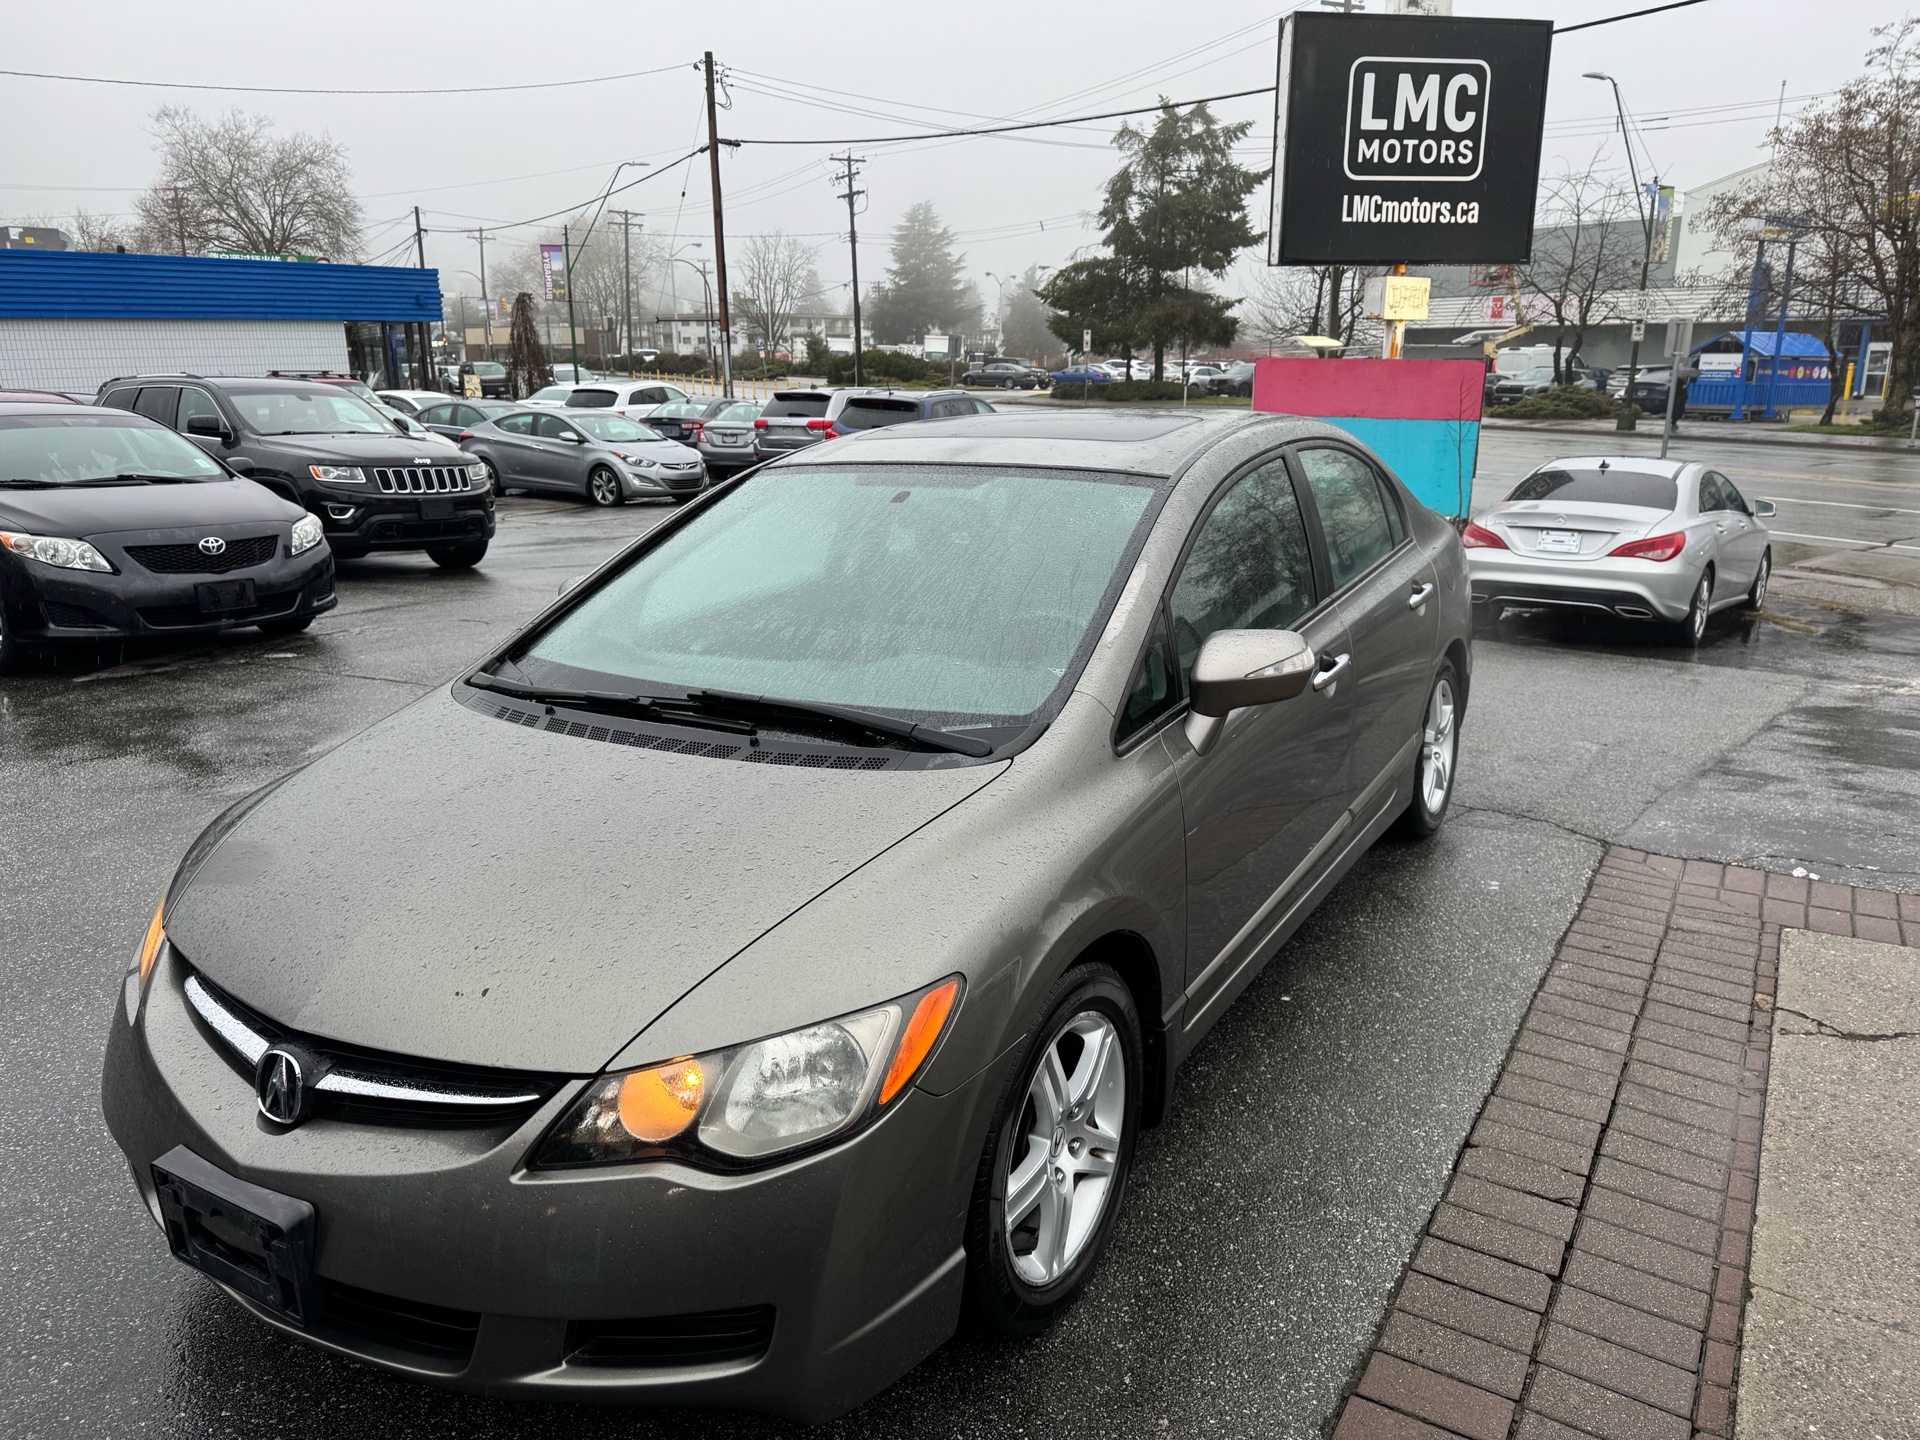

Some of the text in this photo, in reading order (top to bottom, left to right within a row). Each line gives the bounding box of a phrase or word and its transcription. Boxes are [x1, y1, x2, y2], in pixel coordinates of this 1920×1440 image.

[1360, 72, 1479, 133] LMC
[1357, 138, 1474, 165] MOTORS
[1341, 194, 1480, 224] LMCmotors.ca
[1637, 298, 1647, 311] 50
[413, 457, 432, 465] Jeep
